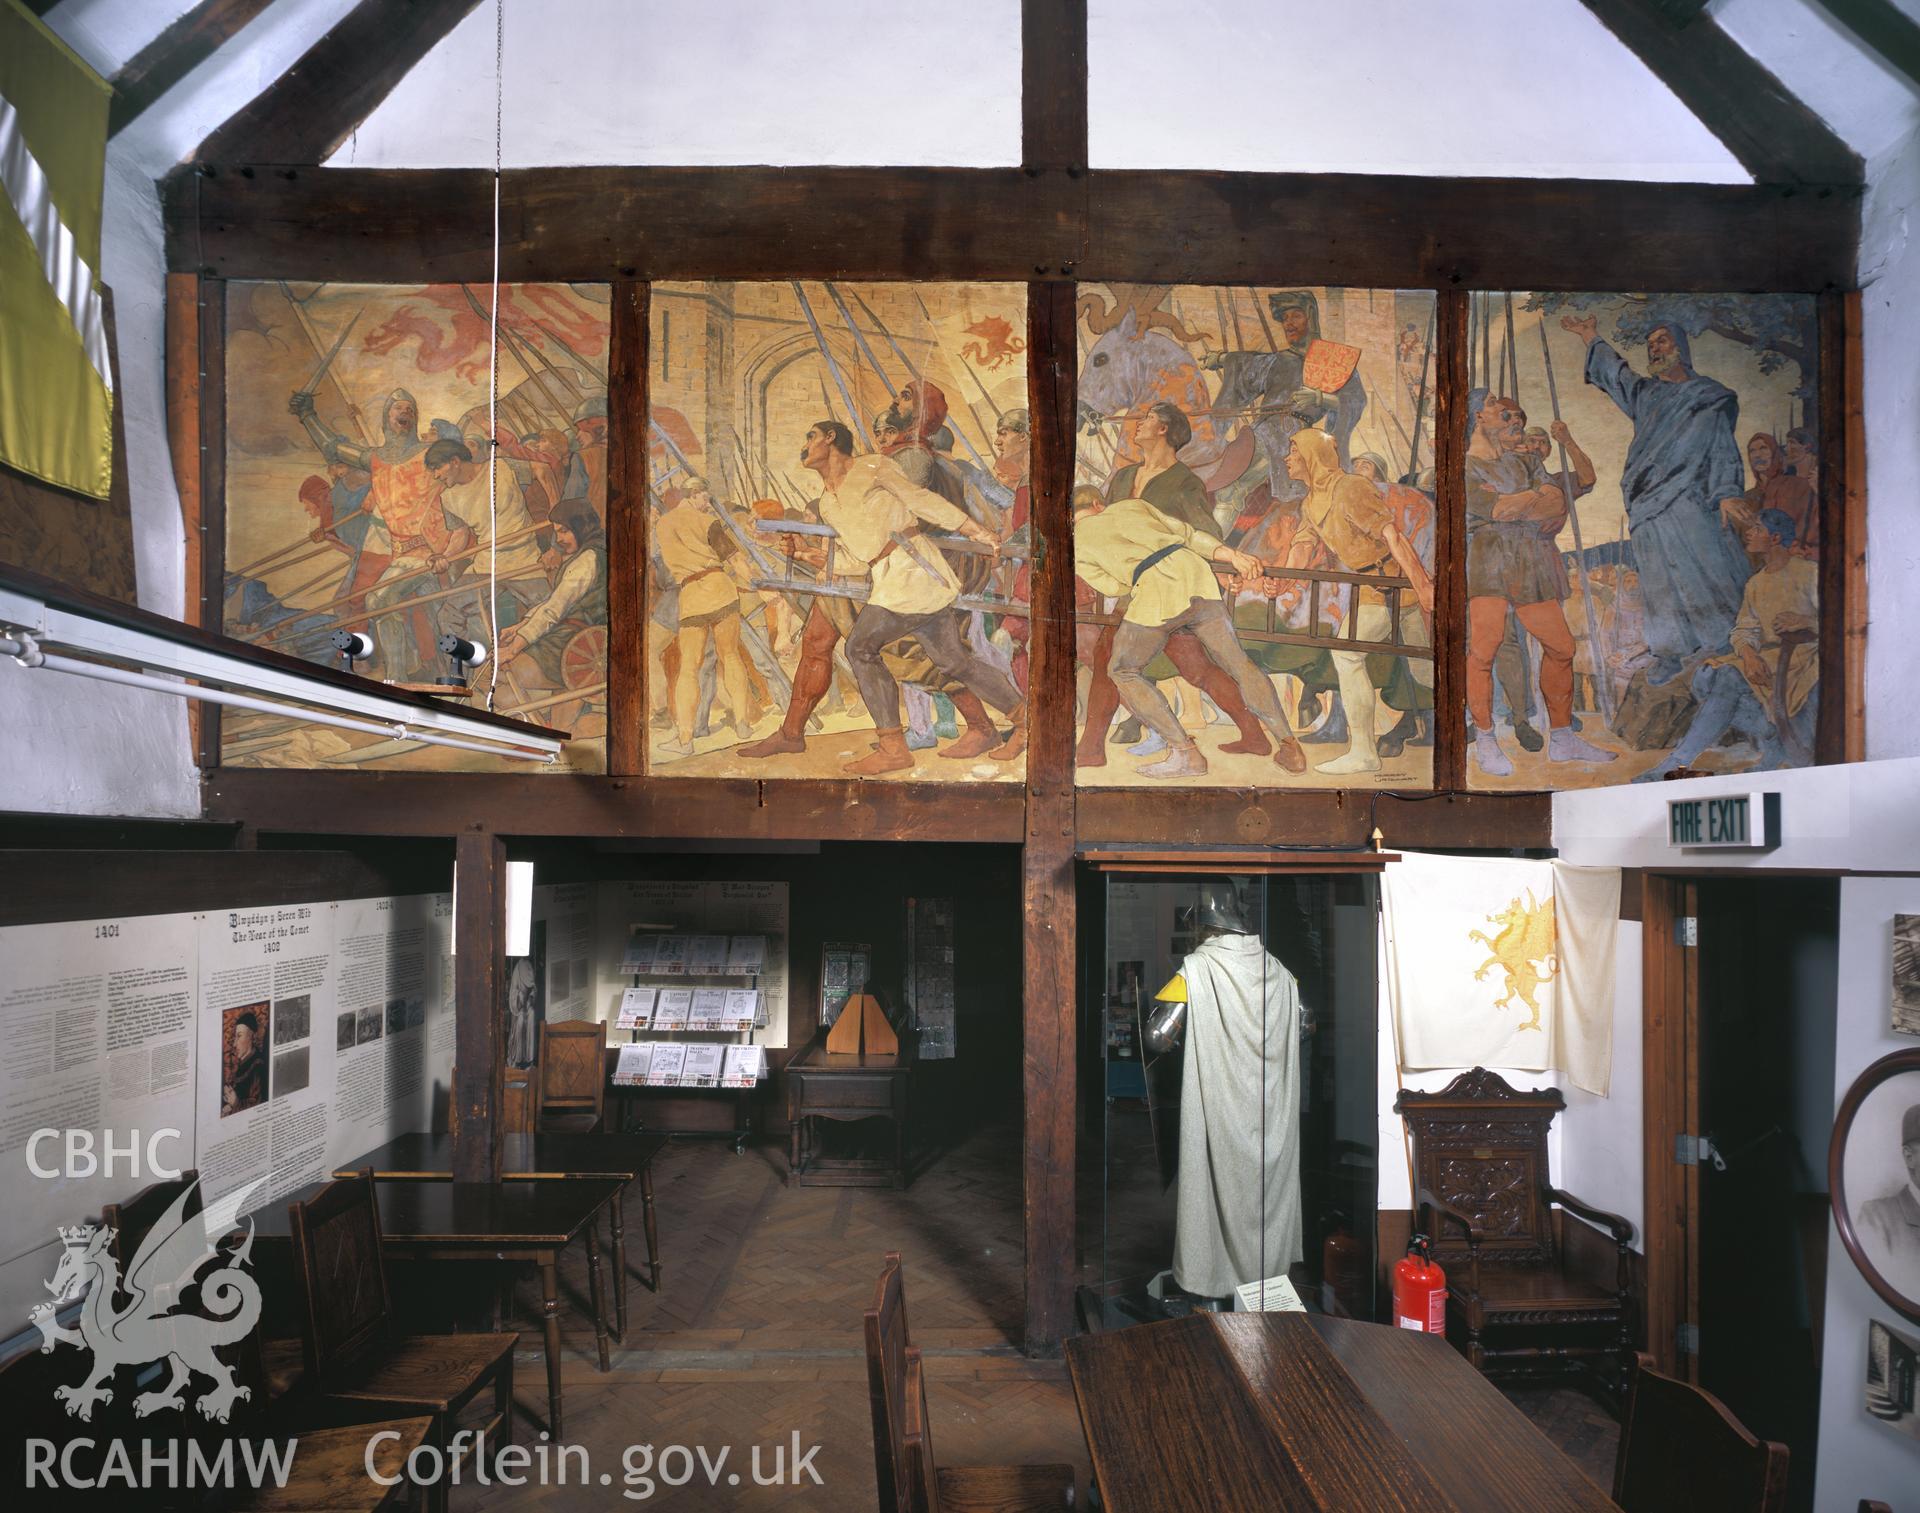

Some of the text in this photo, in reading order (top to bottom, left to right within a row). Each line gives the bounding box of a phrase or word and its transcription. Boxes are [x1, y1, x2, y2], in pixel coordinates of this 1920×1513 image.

[1672, 799, 1748, 843] FIRE EXIT
[278, 911, 296, 921] Seren
[95, 924, 119, 938] 1401
[232, 925, 309, 943] The Year of the Comet
[264, 942, 280, 953] 1402
